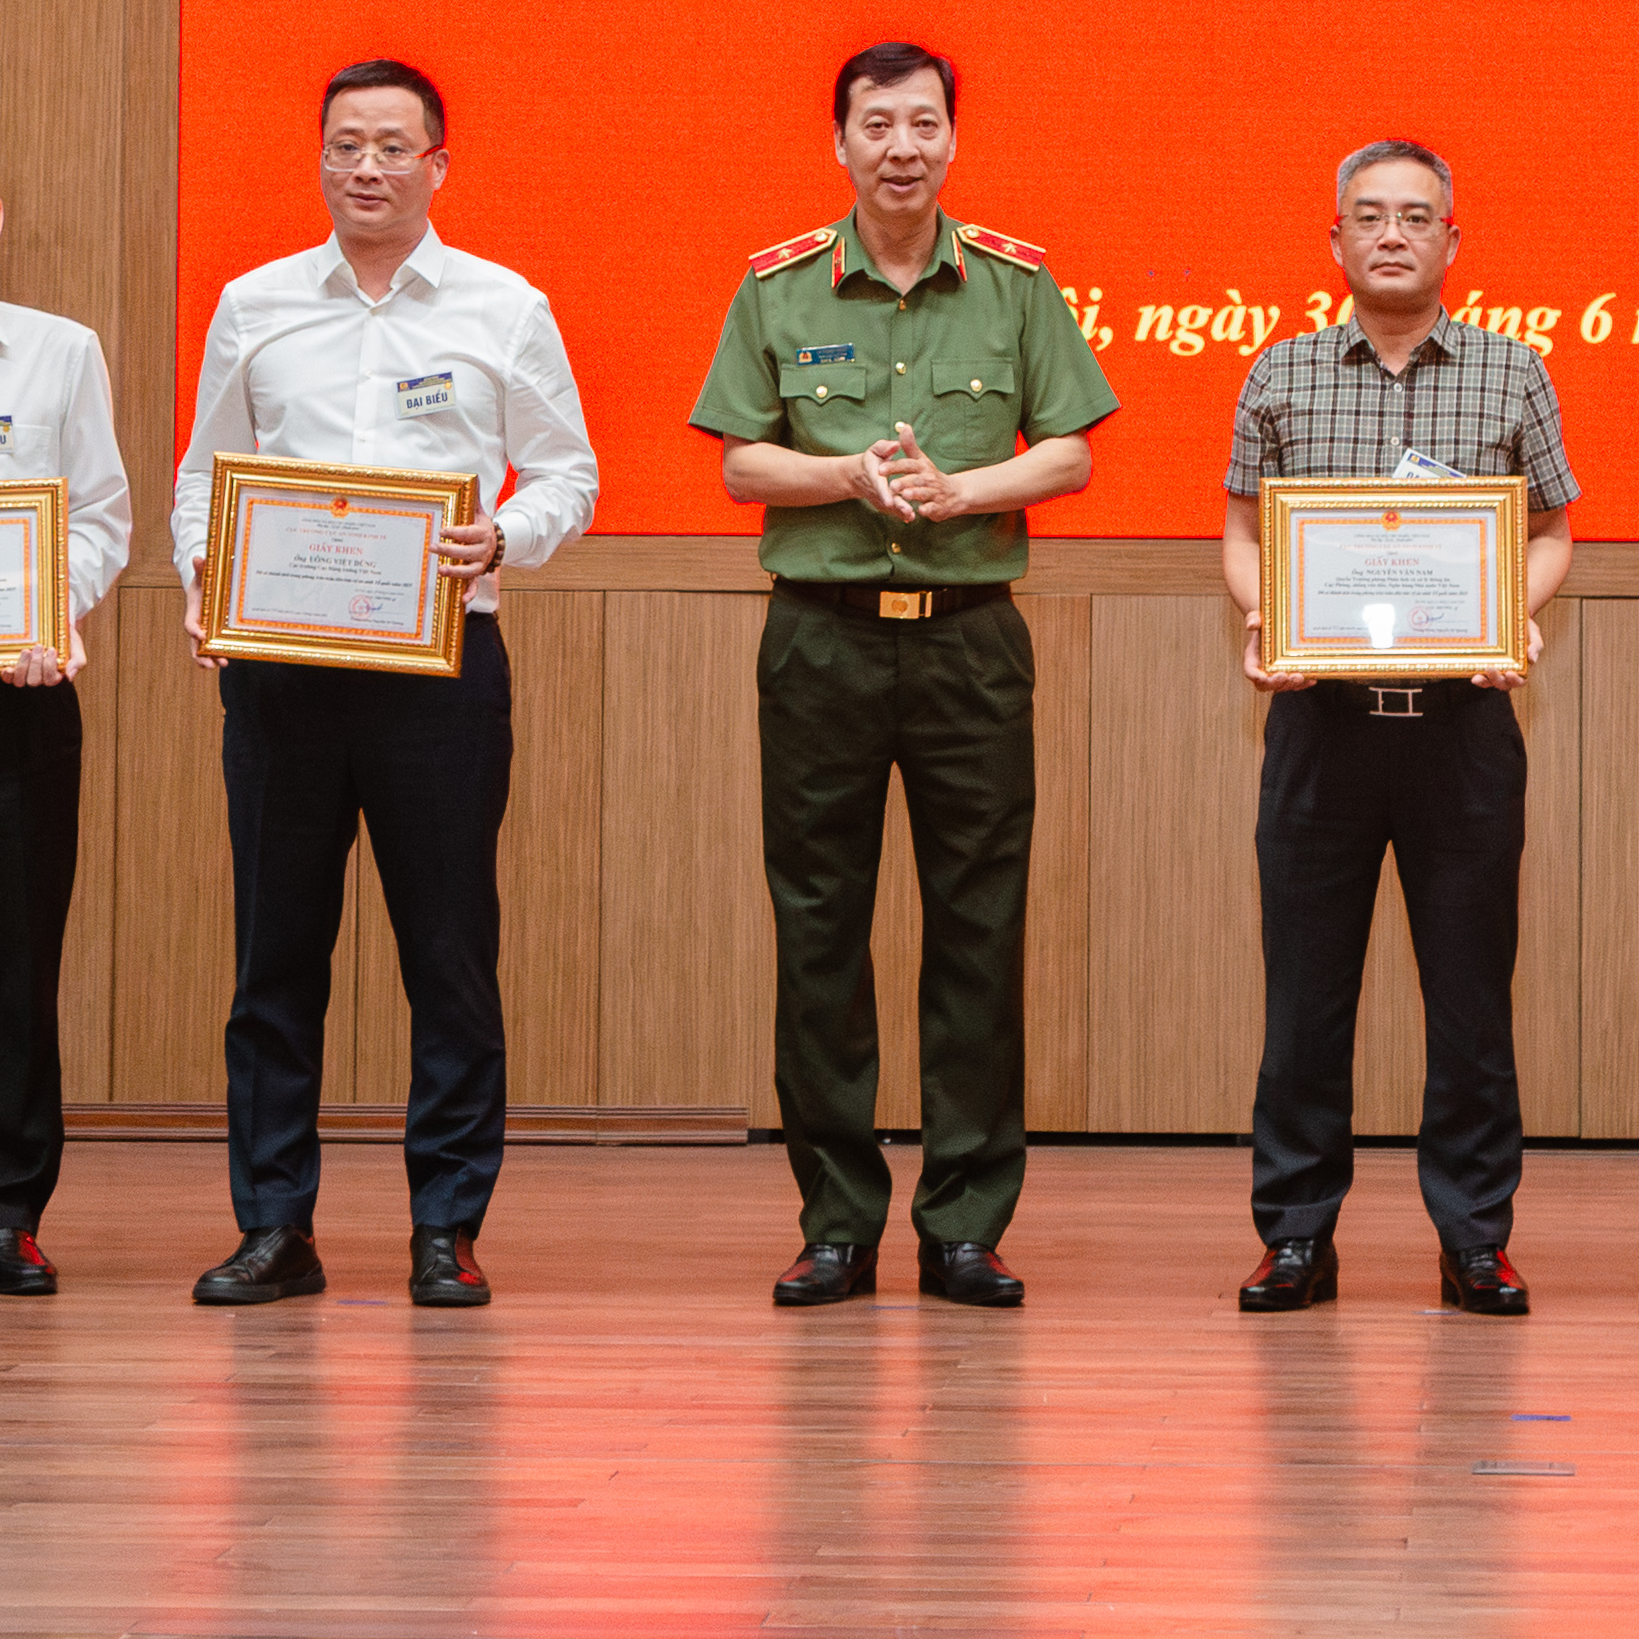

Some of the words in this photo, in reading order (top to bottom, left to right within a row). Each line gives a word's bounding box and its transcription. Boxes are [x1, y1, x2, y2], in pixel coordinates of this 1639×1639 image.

[1135, 290, 1281, 358] ngày
[1580, 293, 1618, 345] 6
[406, 397, 423, 411] ĐẠI
[426, 390, 448, 405] BIỂU
[309, 542, 334, 553] GIẤY
[335, 545, 364, 555] KHEN
[1364, 555, 1389, 566] GIẤY
[1391, 558, 1420, 566] KHEN
